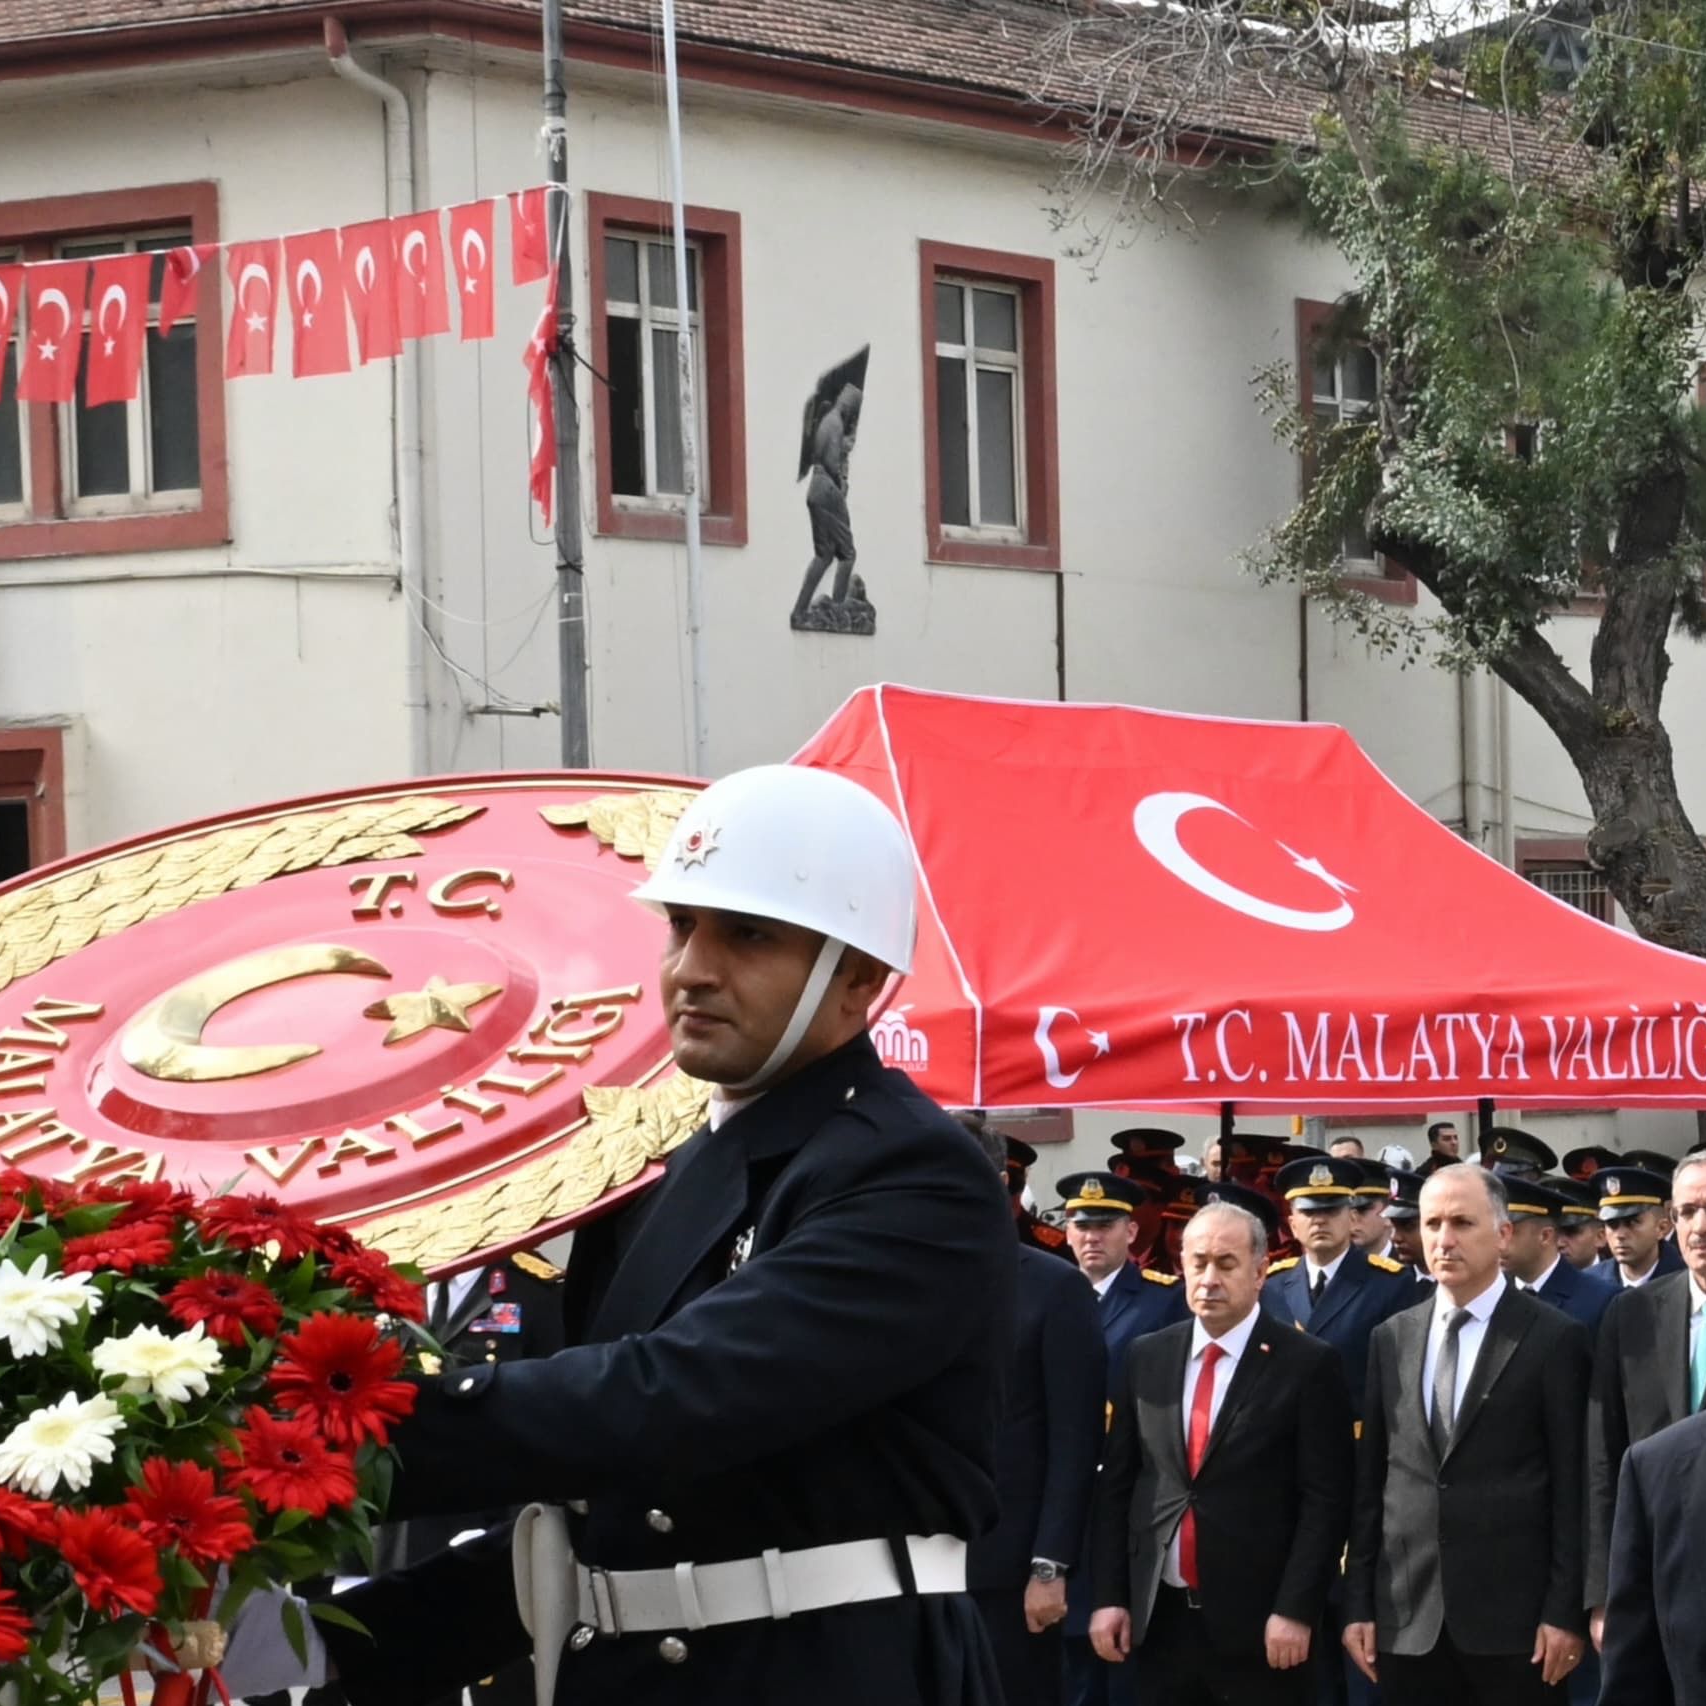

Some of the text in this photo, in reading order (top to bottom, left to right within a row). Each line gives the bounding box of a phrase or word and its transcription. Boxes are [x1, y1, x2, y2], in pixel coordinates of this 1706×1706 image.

[244, 983, 643, 1184] VALİLİĞİ
[1173, 1009, 1268, 1083] T.C.
[1284, 1010, 1530, 1083] MALATYA
